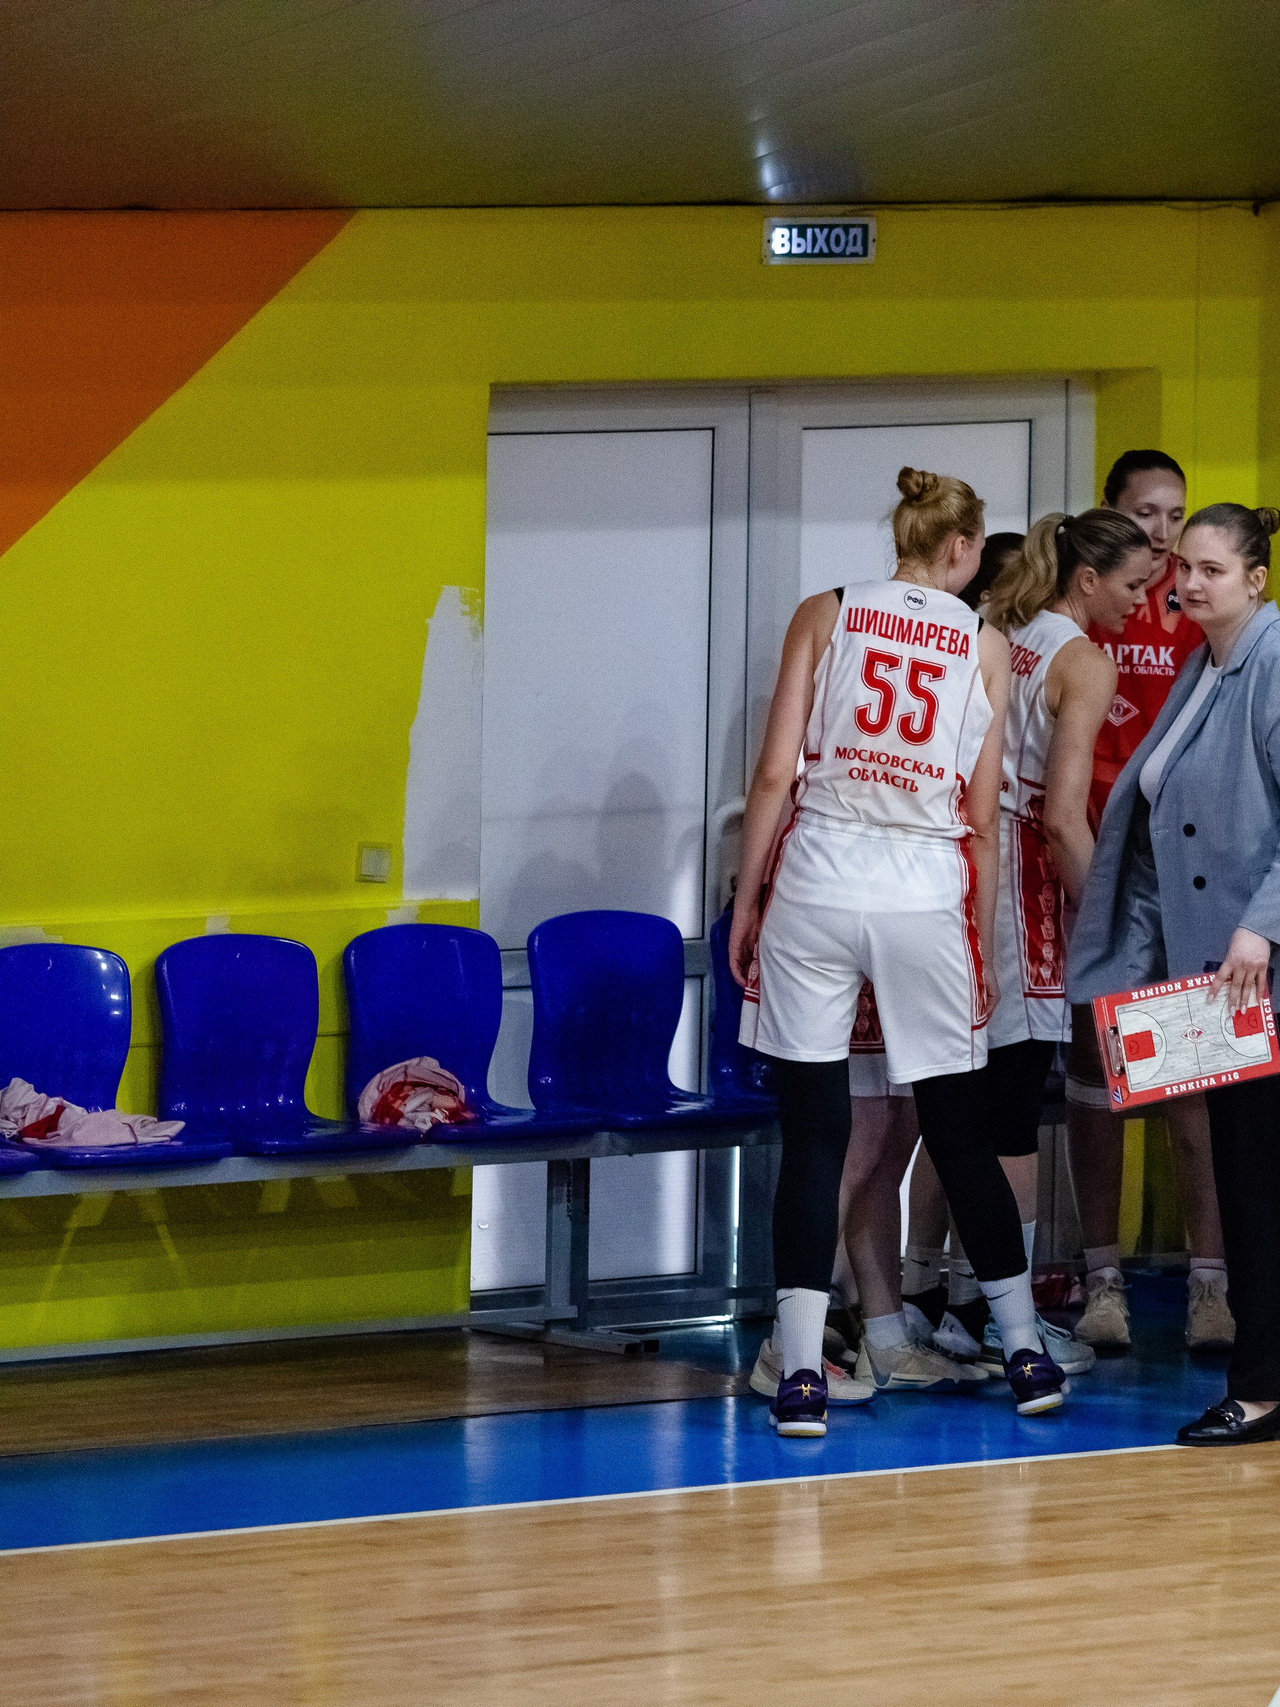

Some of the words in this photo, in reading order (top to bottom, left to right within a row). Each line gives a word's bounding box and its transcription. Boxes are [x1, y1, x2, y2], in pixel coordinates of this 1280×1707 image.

[772, 227, 864, 255] ВЫХОД
[846, 607, 970, 660] ШИШМАРЕВА
[854, 646, 947, 746] 55
[834, 746, 945, 781] МОСКОВСКАЯ
[848, 767, 919, 793] ОБЛАСТЬ
[1131, 982, 1182, 1000] NOGINSK
[1263, 998, 1276, 1037] COACH
[1165, 1077, 1217, 1095] ZENKINA
